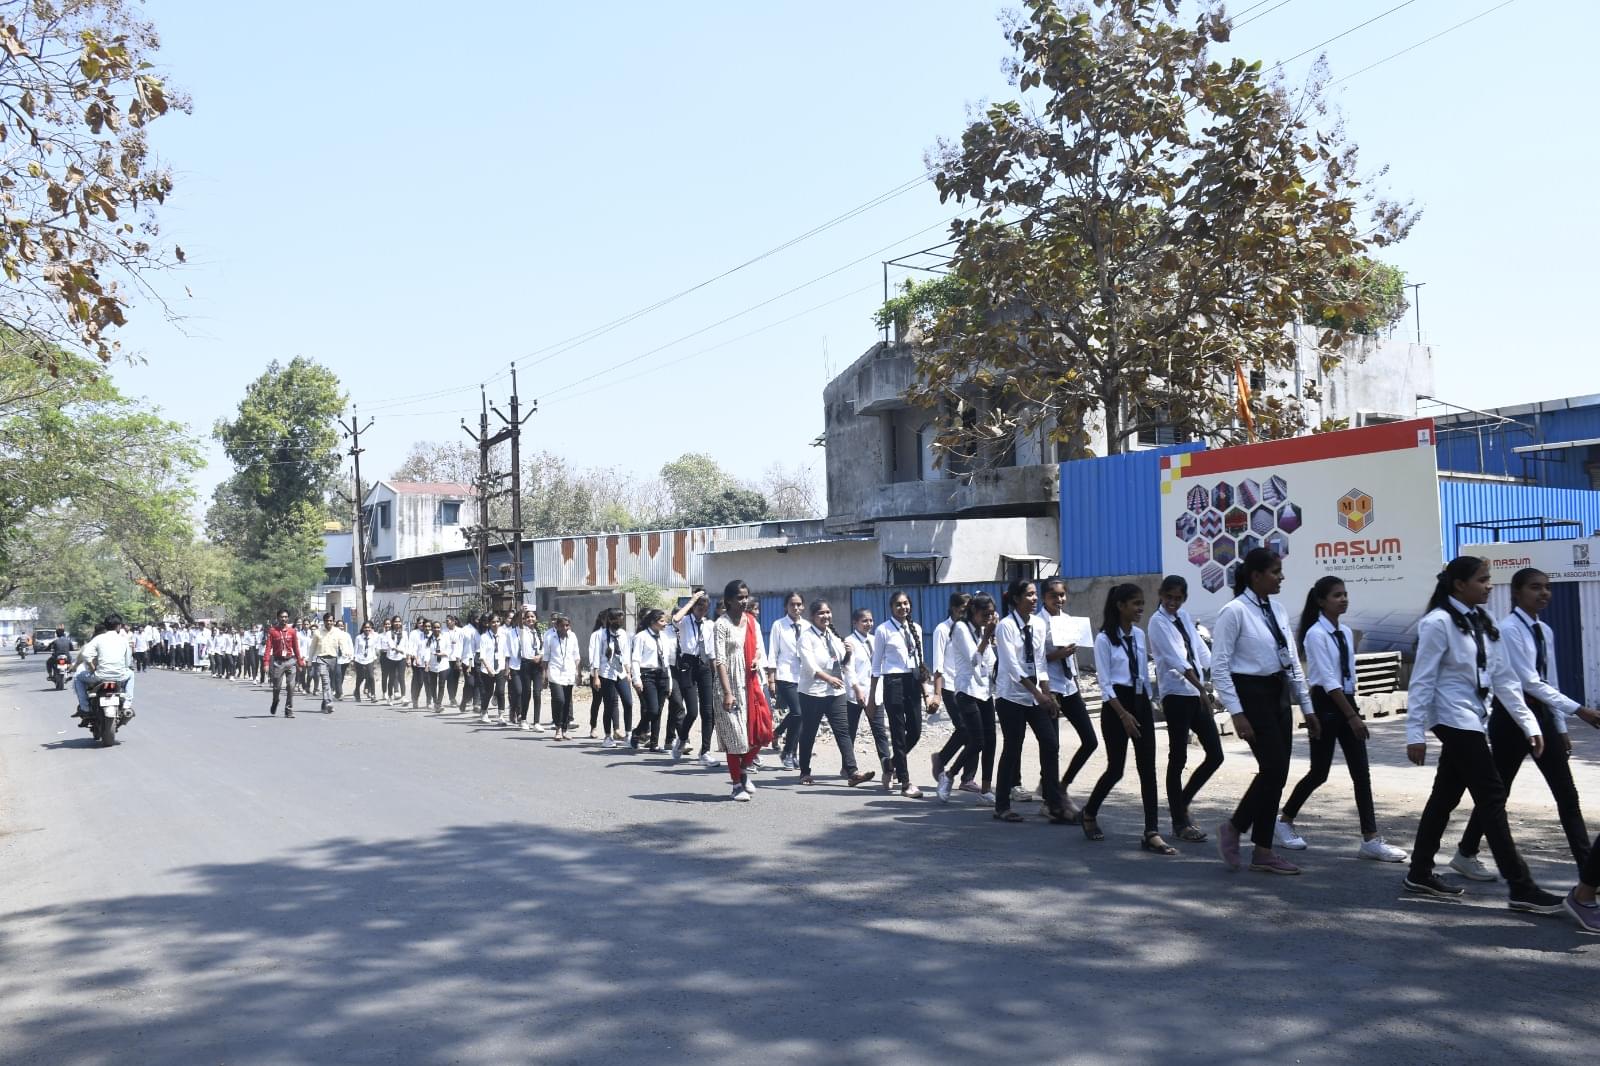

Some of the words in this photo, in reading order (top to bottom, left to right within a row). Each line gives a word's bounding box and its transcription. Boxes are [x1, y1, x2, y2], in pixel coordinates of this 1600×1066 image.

[1315, 538, 1401, 558] MASUM
[1315, 555, 1402, 565] INDUSTRIES
[1493, 557, 1531, 567] MASUM
[1373, 562, 1395, 570] Company
